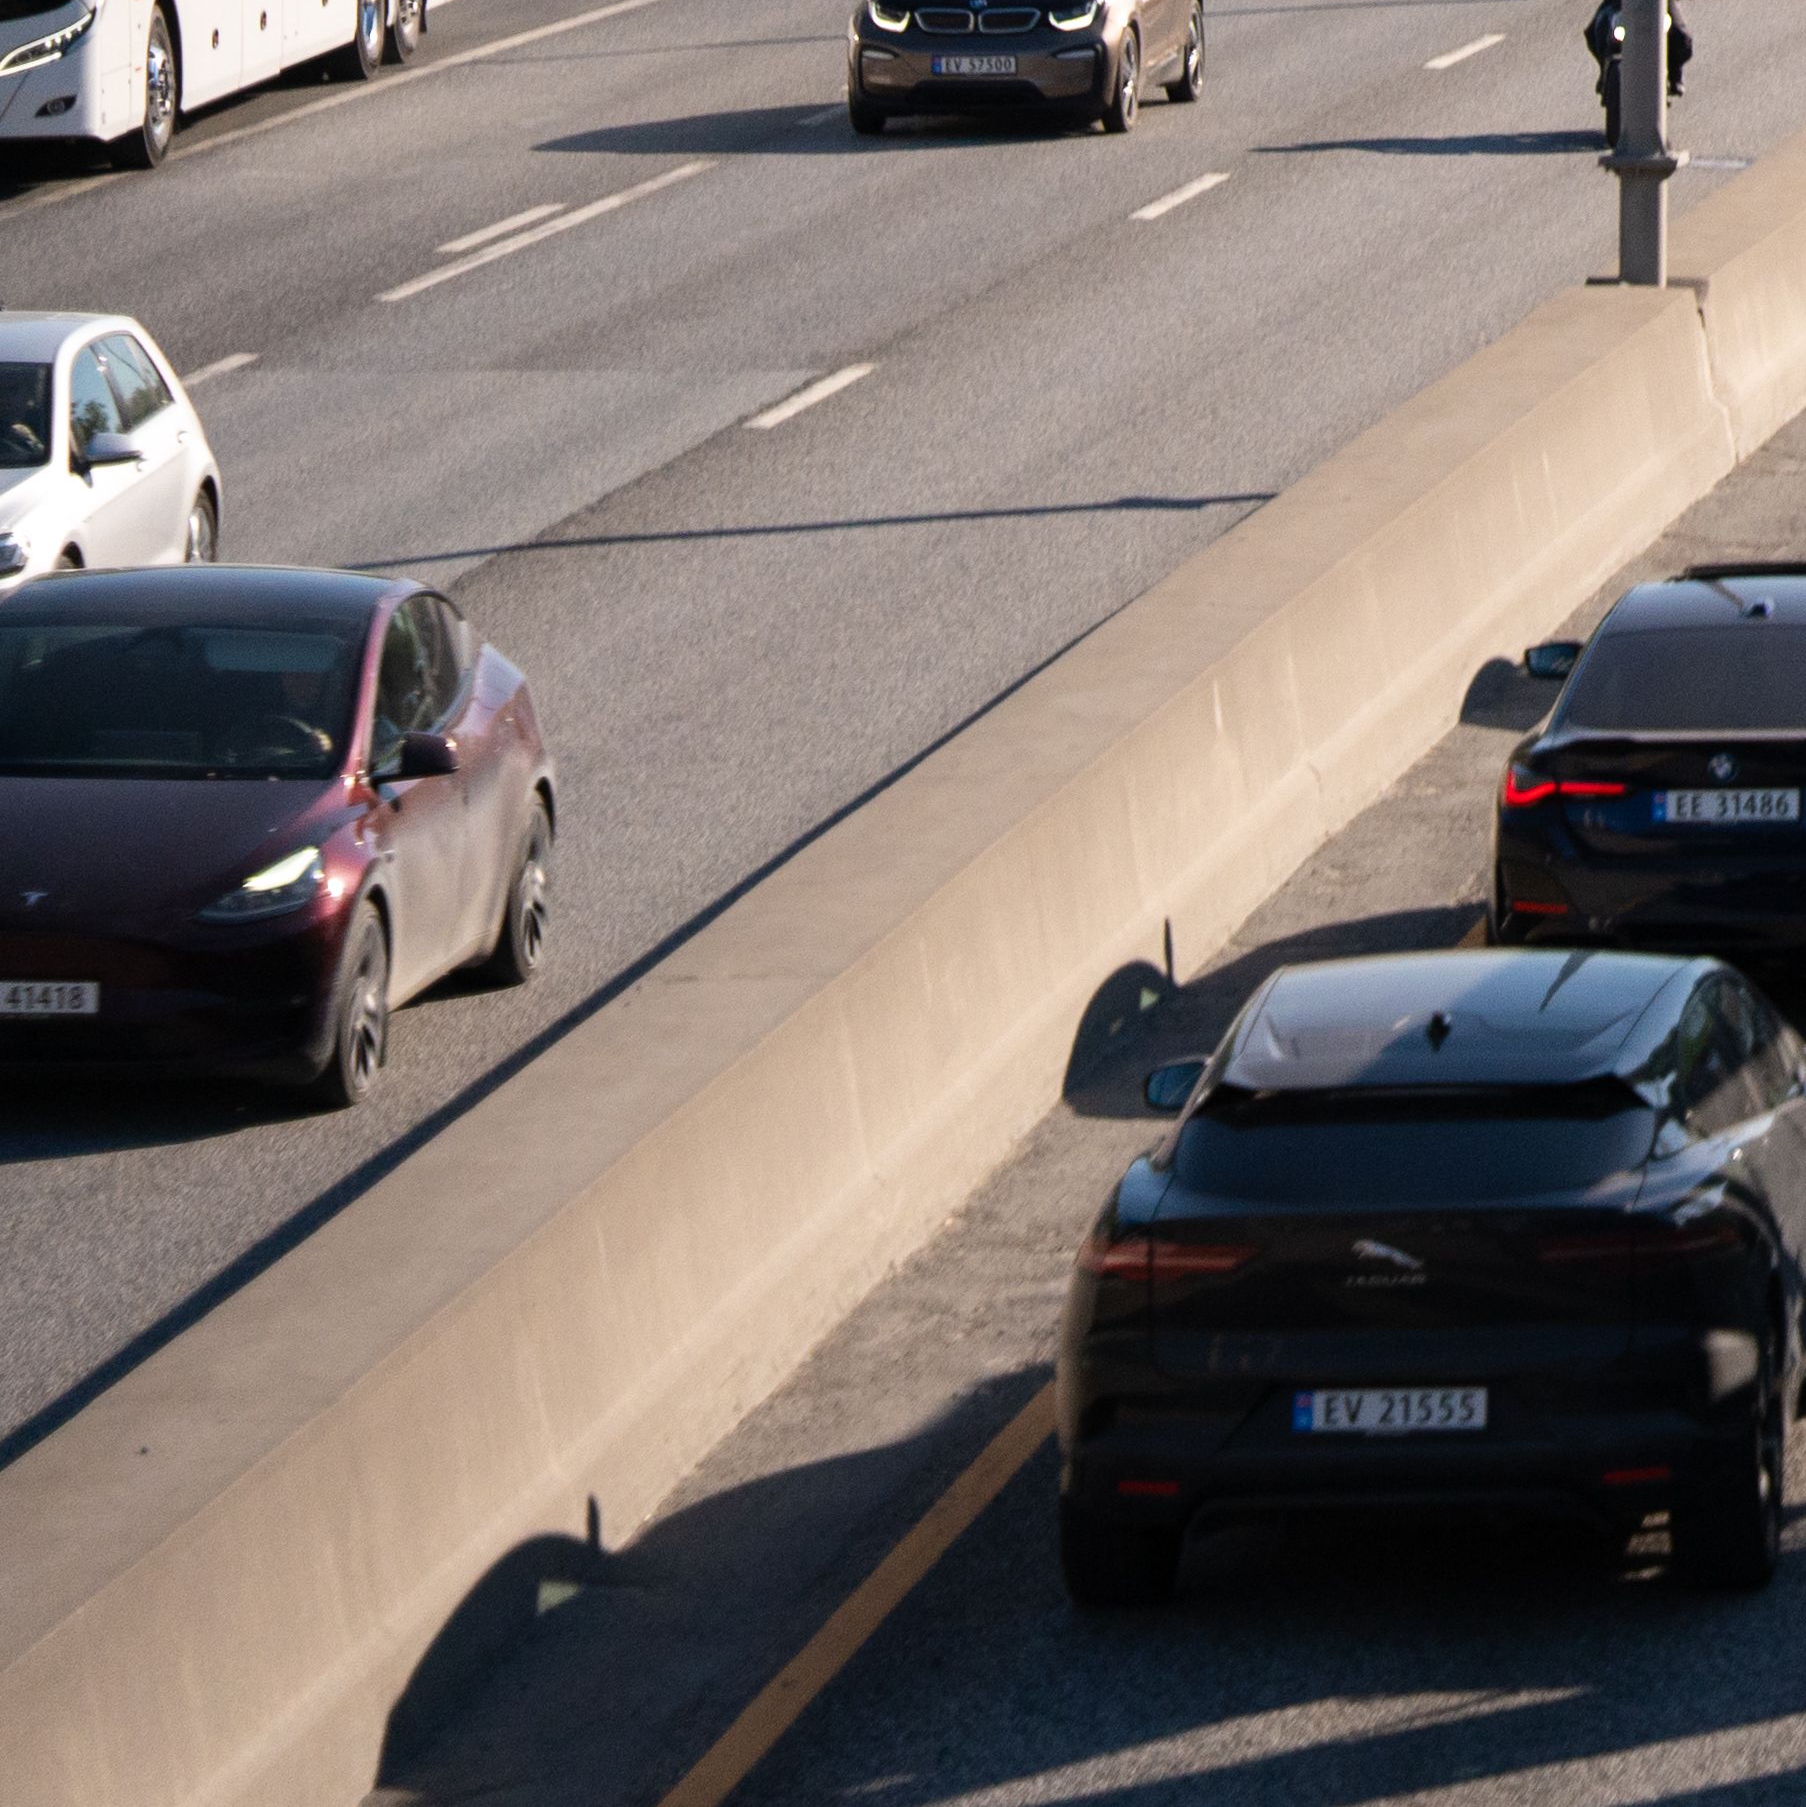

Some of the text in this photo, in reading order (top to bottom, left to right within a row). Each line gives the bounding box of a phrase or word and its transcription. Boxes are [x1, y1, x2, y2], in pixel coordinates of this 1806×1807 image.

[1675, 793, 1790, 817] EE 31486
[5, 985, 85, 1010] 41418
[1323, 1393, 1475, 1425] EV 21555
